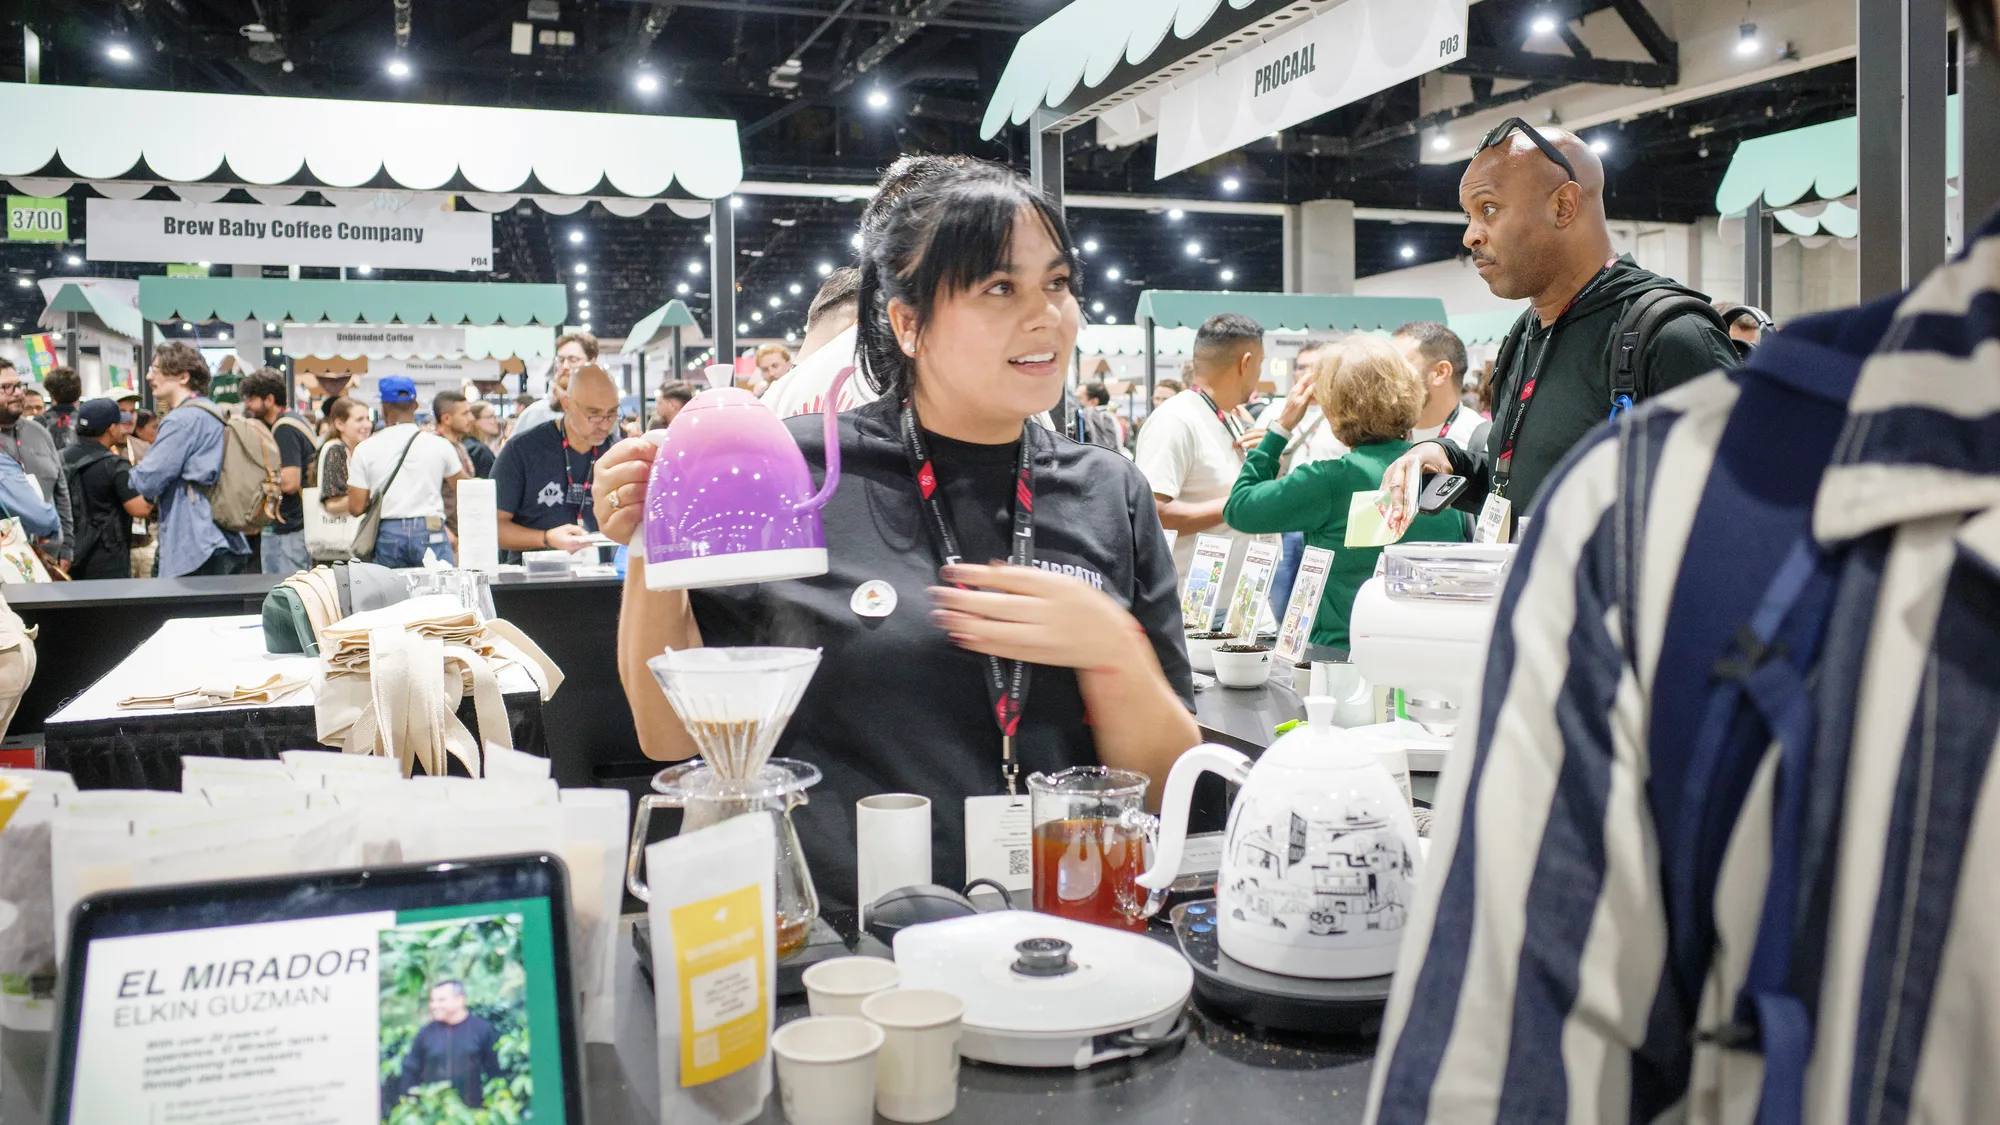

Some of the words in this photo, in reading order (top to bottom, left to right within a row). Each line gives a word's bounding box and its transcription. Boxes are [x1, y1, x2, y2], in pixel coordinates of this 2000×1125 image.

[1439, 34, 1460, 58] P03
[1254, 42, 1316, 98] PROCAAL
[12, 209, 64, 232] 3700
[164, 216, 214, 235] Brew
[219, 218, 267, 239] Baby
[271, 220, 333, 240] Coffee
[338, 222, 424, 244] Company
[470, 257, 488, 266] P04
[336, 332, 384, 342] Unblended
[386, 333, 414, 342] Coffee
[904, 408, 924, 461] STRONGHOLD
[1509, 402, 1526, 440] STRONGHOLD
[117, 969, 166, 1000] EL
[181, 948, 371, 992] MIRADOR
[113, 999, 199, 1029] ELKIN
[207, 985, 330, 1018] GUZMAN
